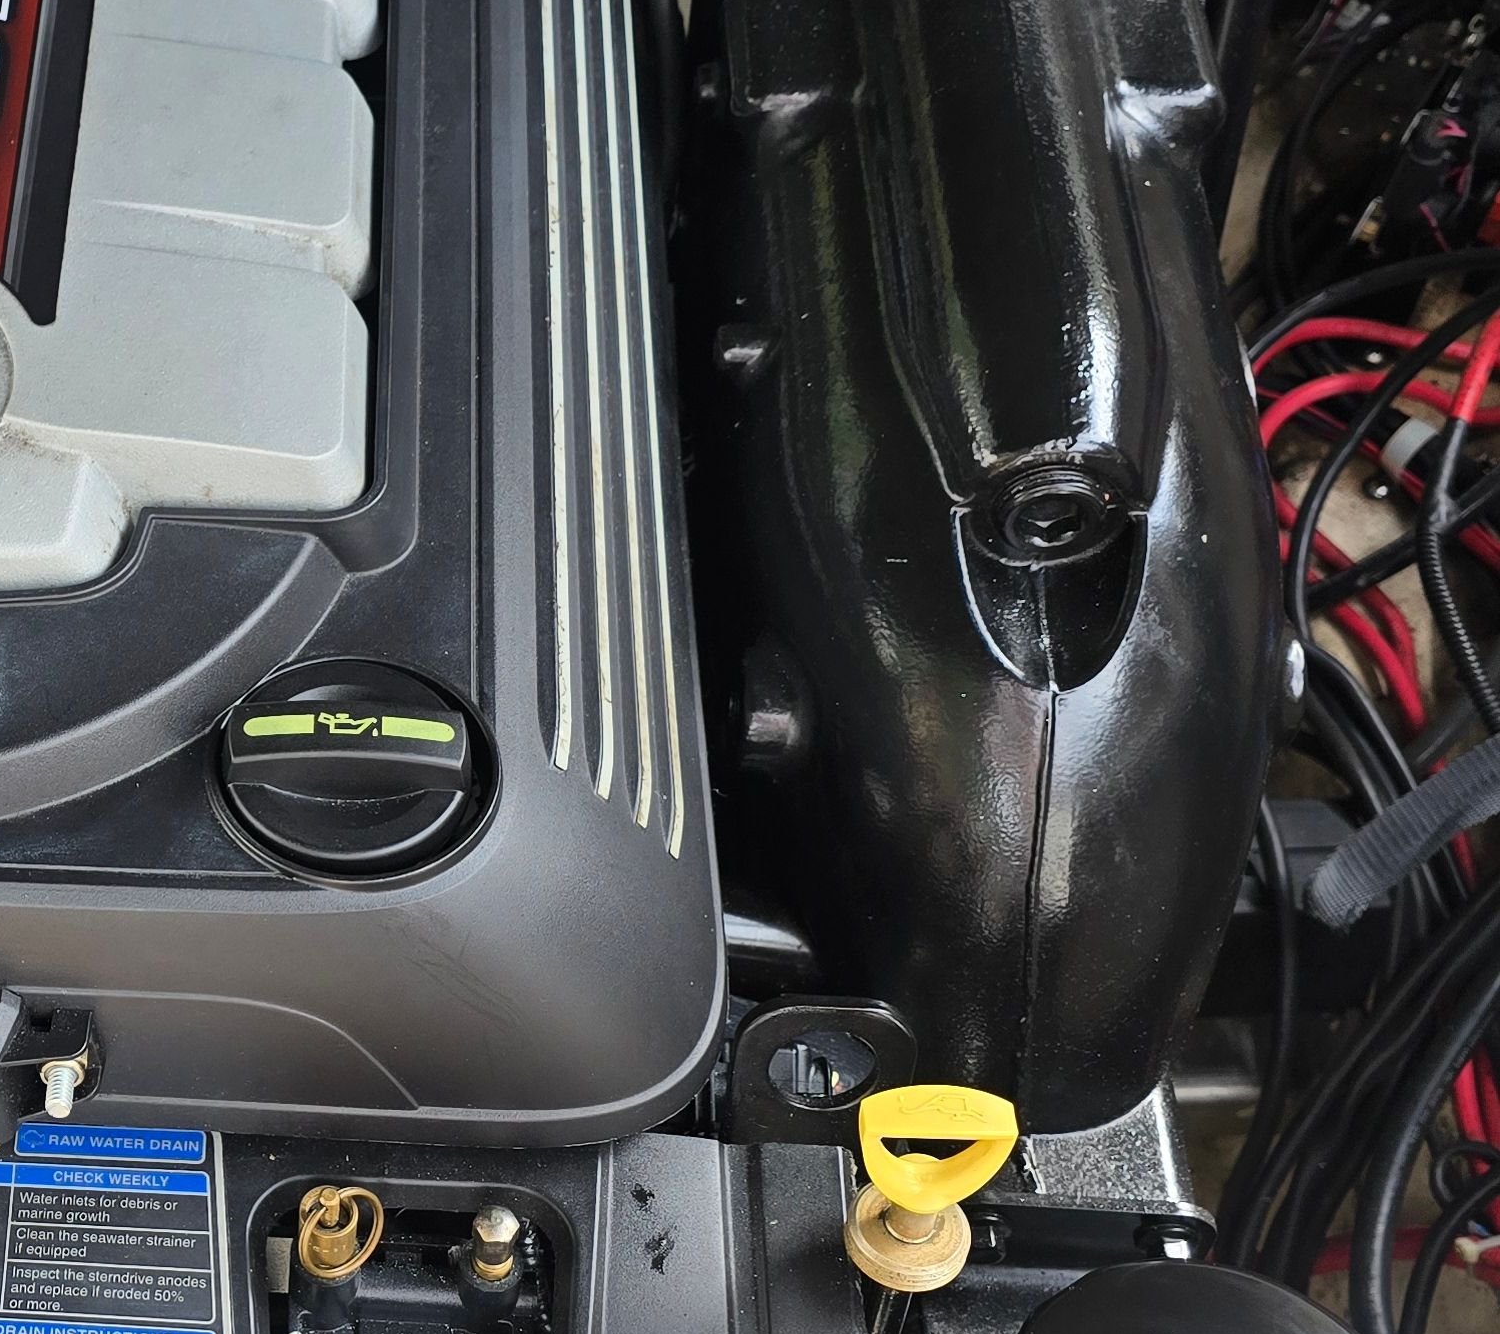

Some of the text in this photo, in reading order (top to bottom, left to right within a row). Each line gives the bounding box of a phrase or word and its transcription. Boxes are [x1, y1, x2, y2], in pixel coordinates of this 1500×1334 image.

[48, 1134, 200, 1154] RAW WATER DRAIN
[52, 1170, 170, 1187] CHECK WEEKLY
[19, 1191, 179, 1212] Water inlets for debris or
[17, 1207, 111, 1224] marine growth
[11, 1265, 208, 1290] Inspect the sterndrive anodes
